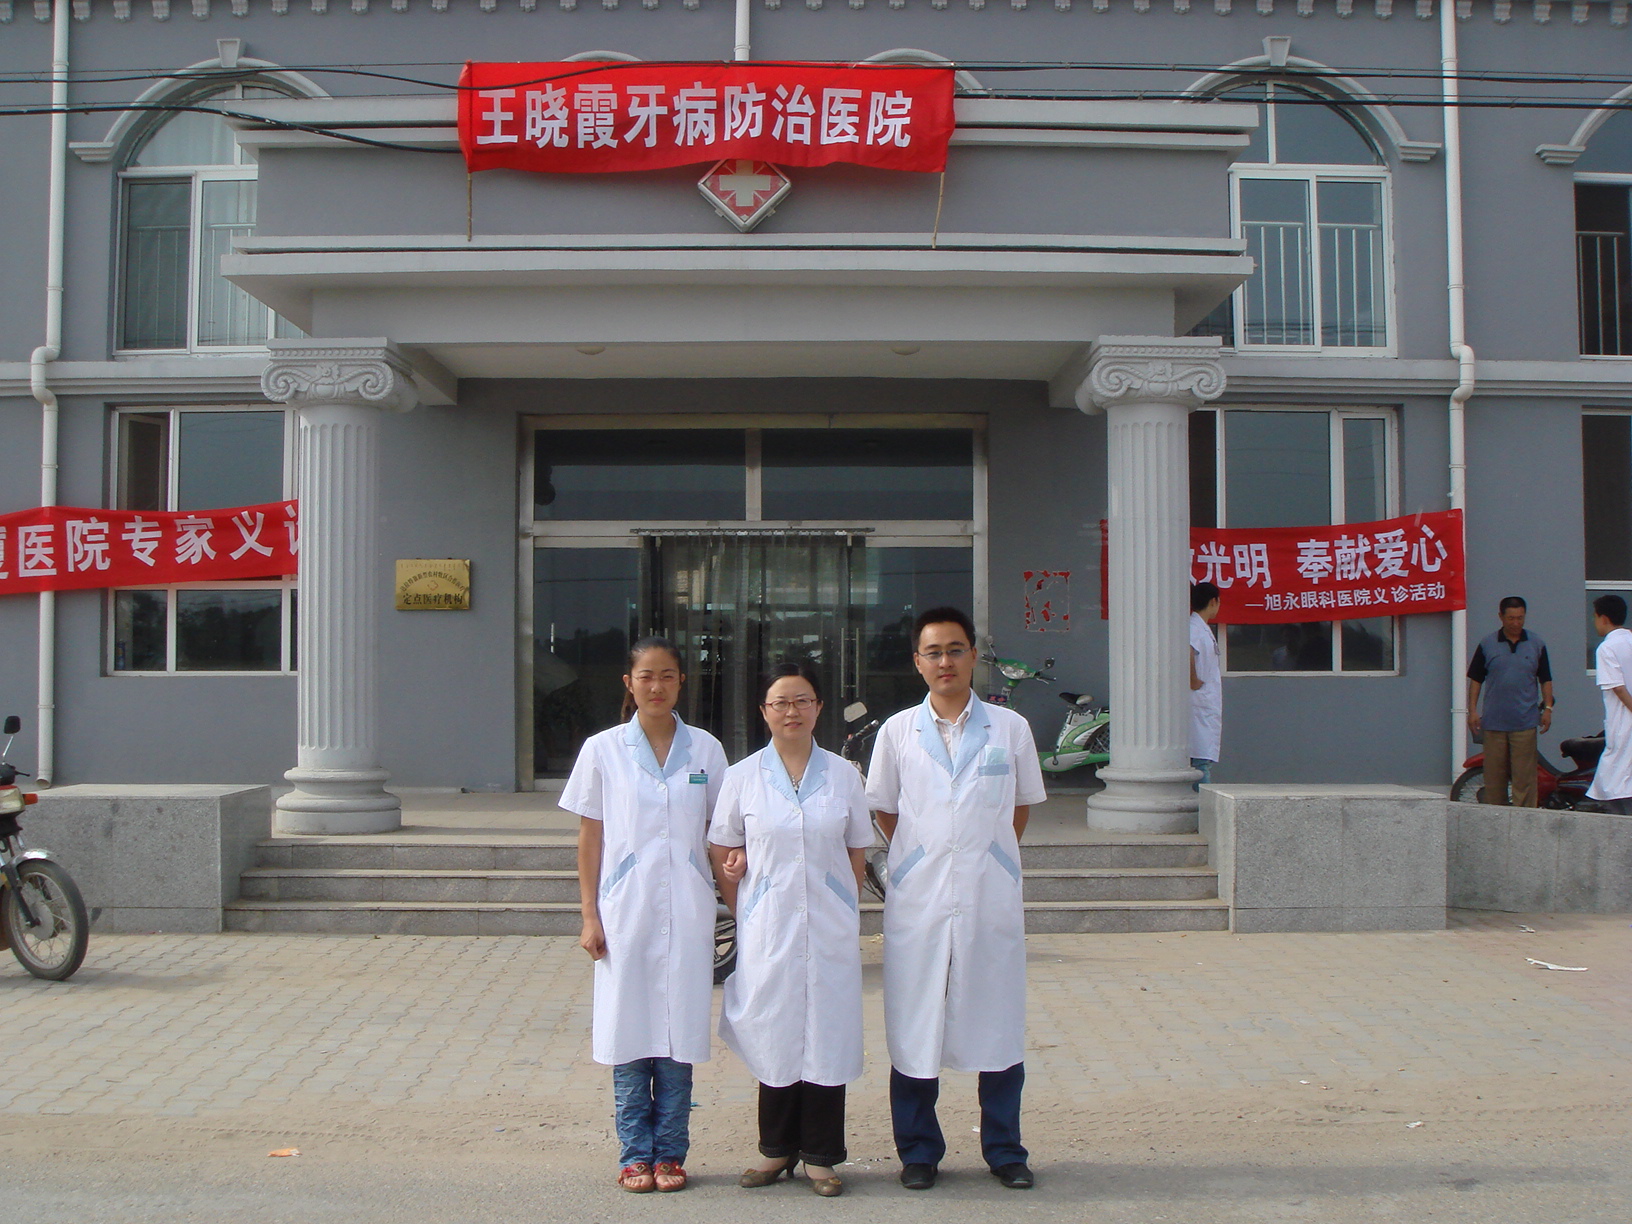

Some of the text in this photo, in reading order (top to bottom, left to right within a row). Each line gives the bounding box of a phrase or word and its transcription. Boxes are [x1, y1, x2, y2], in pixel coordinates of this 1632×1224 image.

[476, 81, 912, 149] 王晓霞牙病防治医院
[0, 504, 298, 579] 医院专家义
[1190, 524, 1448, 589] 光明 奉献爱心
[403, 593, 463, 605] 定点医疗机构
